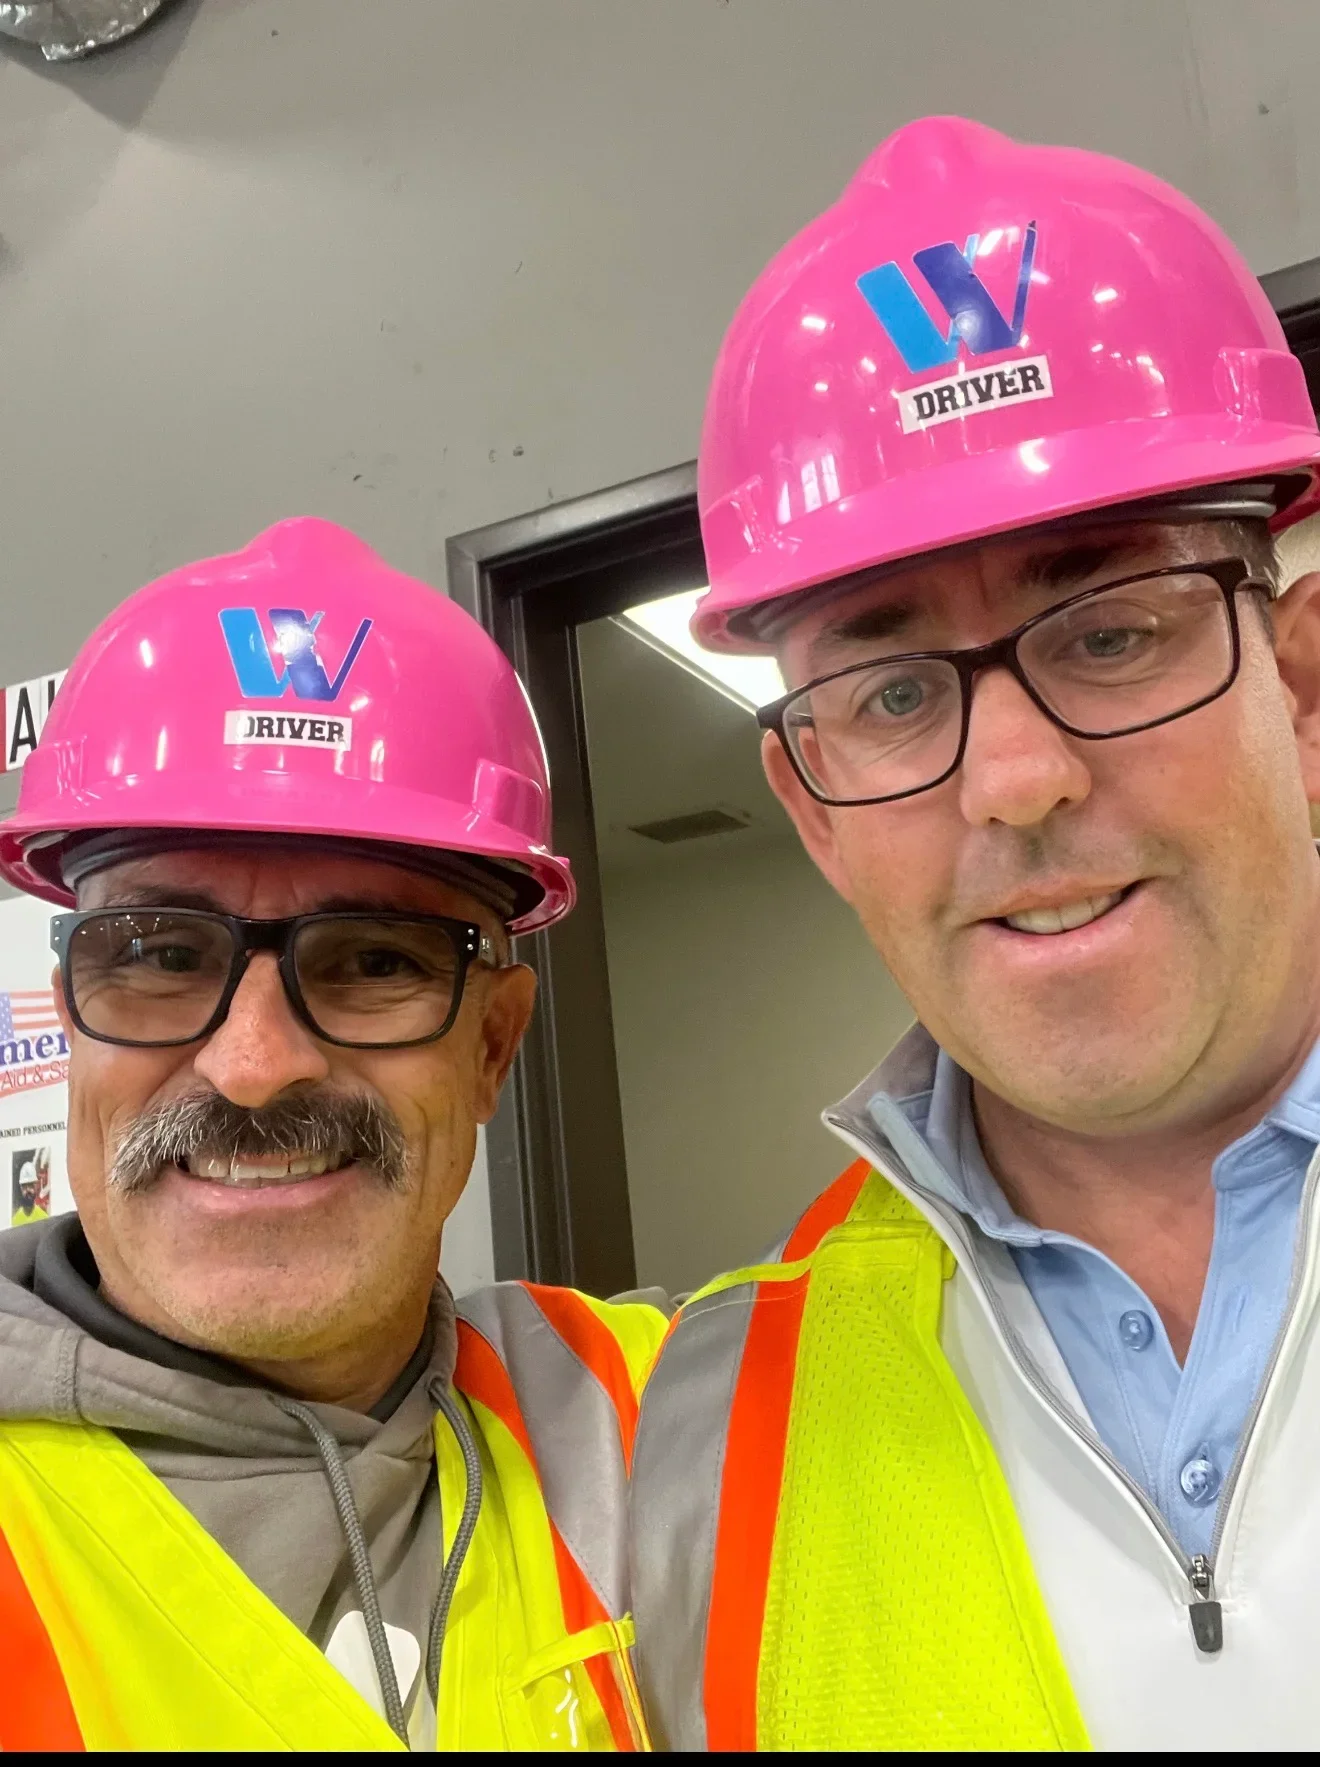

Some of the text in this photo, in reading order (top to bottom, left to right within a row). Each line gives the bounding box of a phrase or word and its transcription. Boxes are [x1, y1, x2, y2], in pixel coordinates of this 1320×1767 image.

[913, 364, 1045, 420] DRIVER
[1, 1066, 27, 1090] Aid
[33, 1064, 44, 1084] &
[23, 1121, 66, 1136] PERSONNEL
